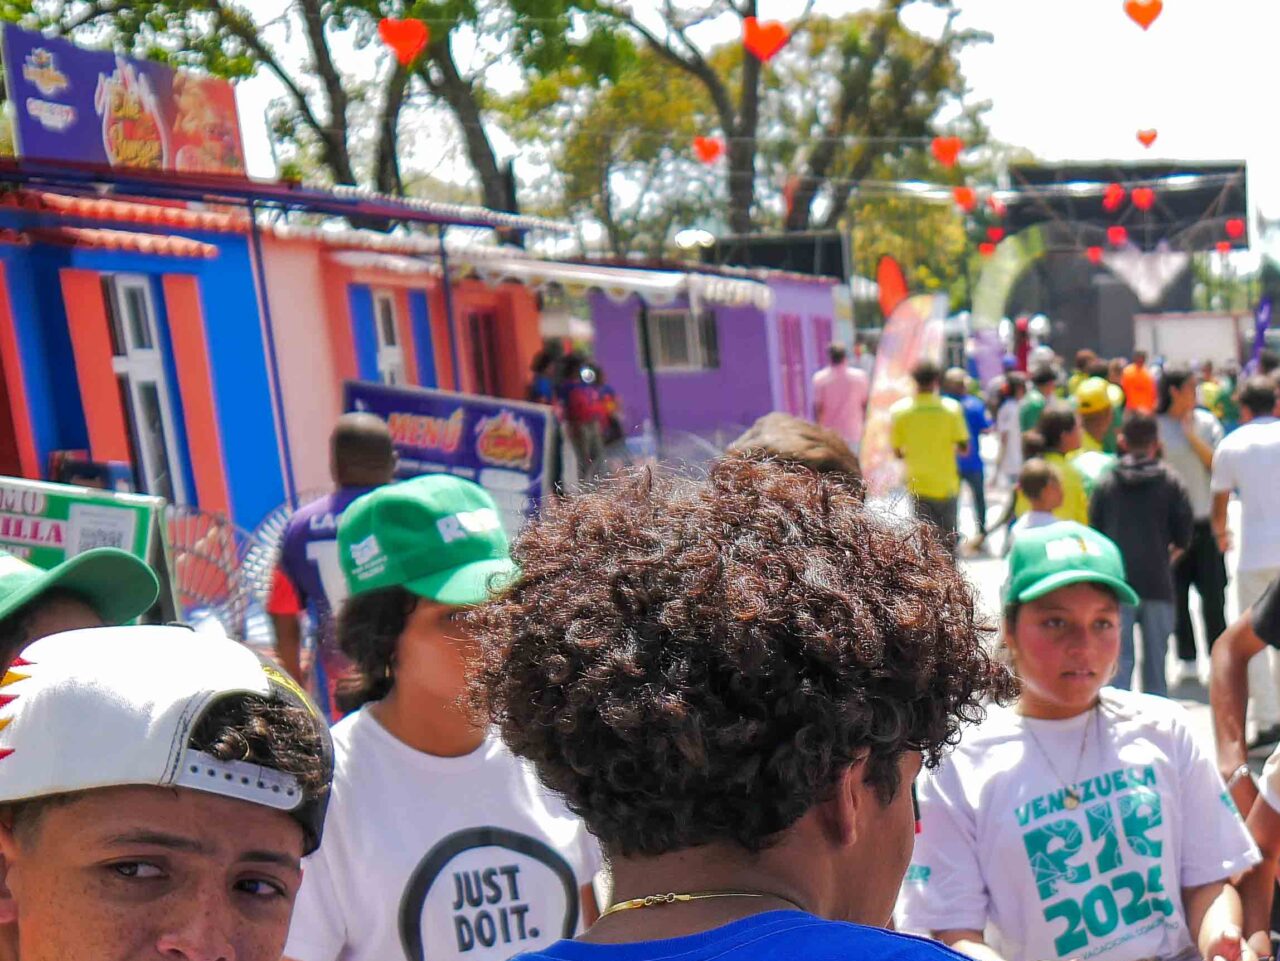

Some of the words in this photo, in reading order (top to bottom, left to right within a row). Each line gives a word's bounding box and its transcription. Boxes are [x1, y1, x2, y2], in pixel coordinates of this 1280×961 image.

[453, 865, 520, 910] JUST
[454, 909, 496, 952] DO
[500, 904, 540, 943] IT.
